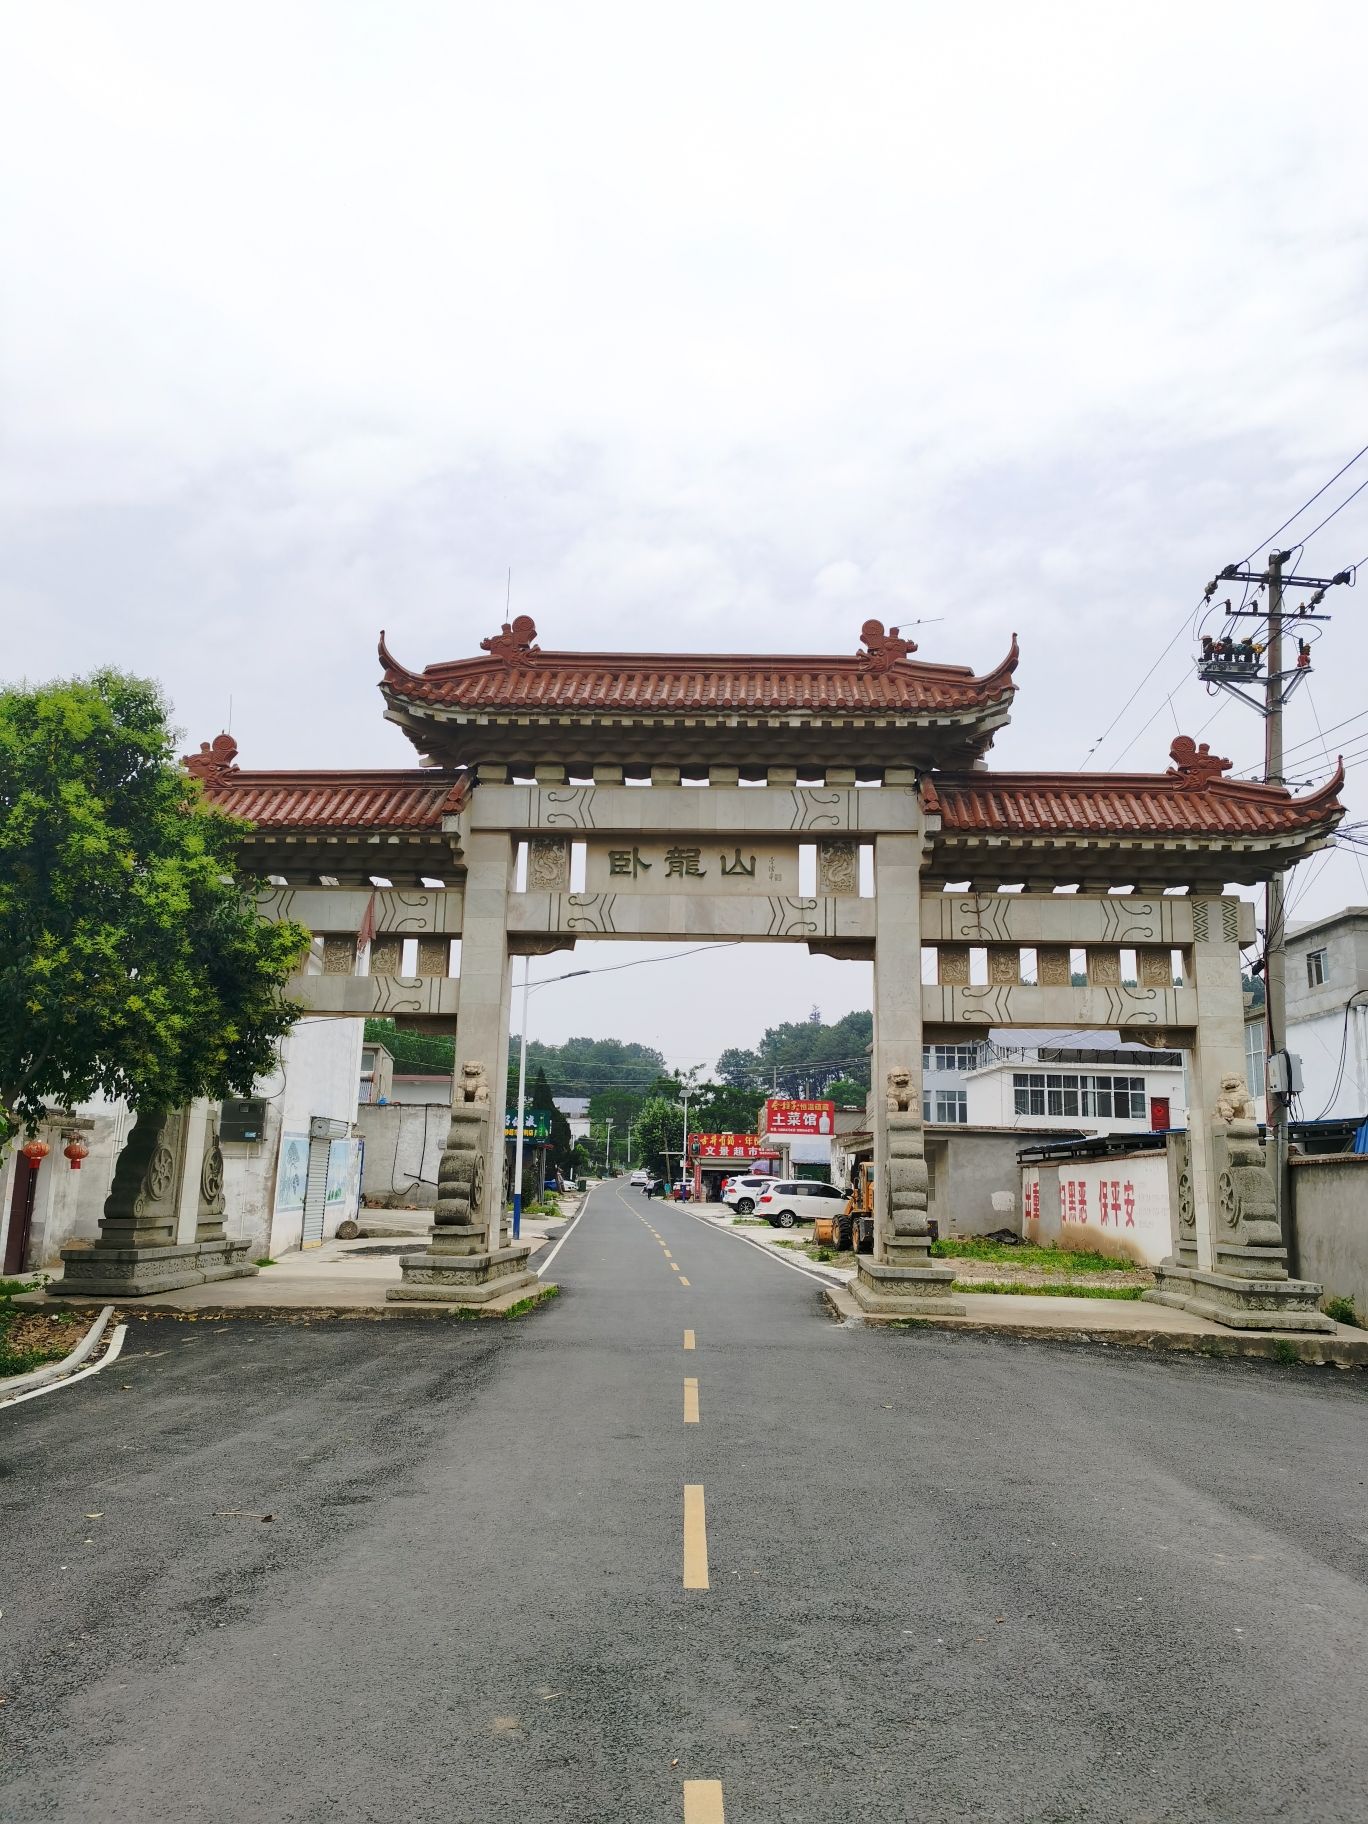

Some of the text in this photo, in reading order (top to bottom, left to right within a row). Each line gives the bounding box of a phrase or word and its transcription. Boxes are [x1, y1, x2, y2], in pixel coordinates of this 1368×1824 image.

[771, 1111, 817, 1126] 土菜馆
[705, 1145, 758, 1156] 文景超市
[1099, 1179, 1136, 1228] 保平安
